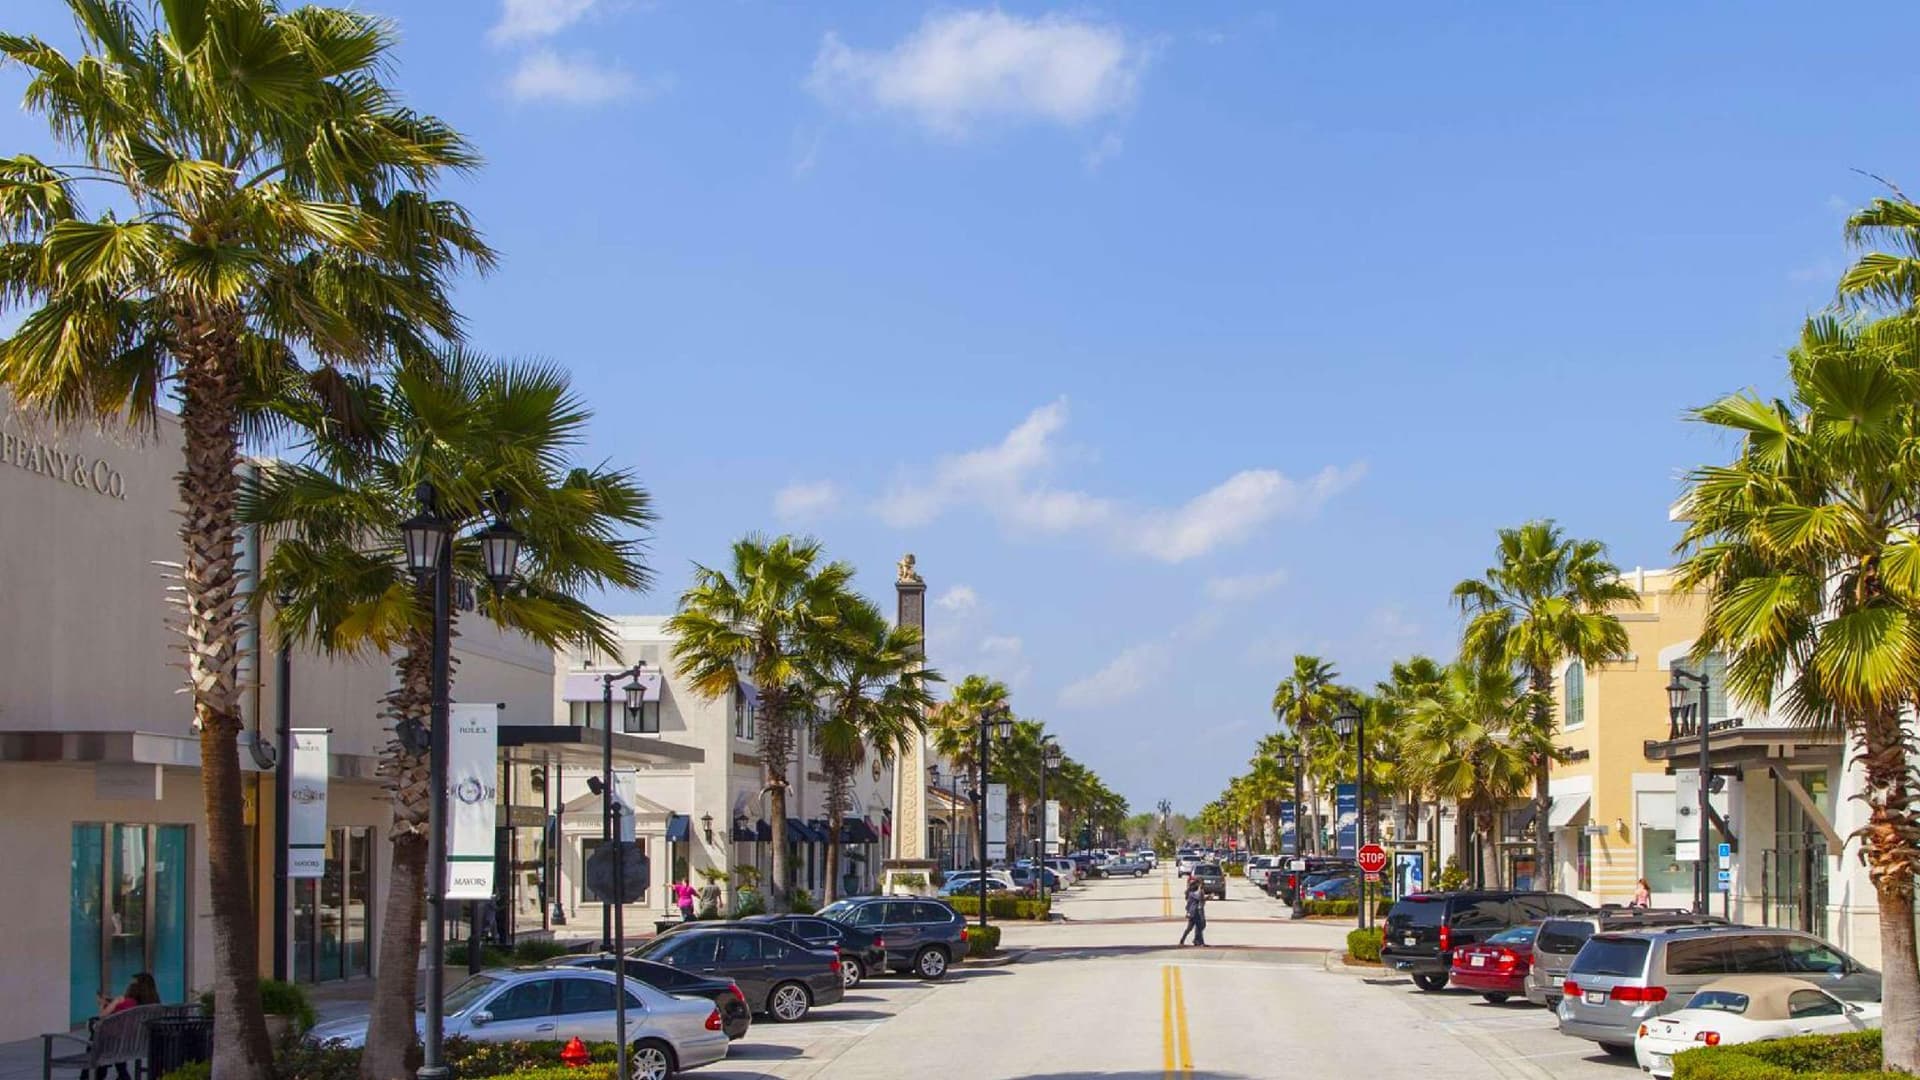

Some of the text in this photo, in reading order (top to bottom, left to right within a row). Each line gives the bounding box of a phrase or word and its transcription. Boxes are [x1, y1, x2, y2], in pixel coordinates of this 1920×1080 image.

[74, 455, 89, 489] &
[1360, 852, 1384, 864] STOP
[454, 877, 487, 887] MAYORS
